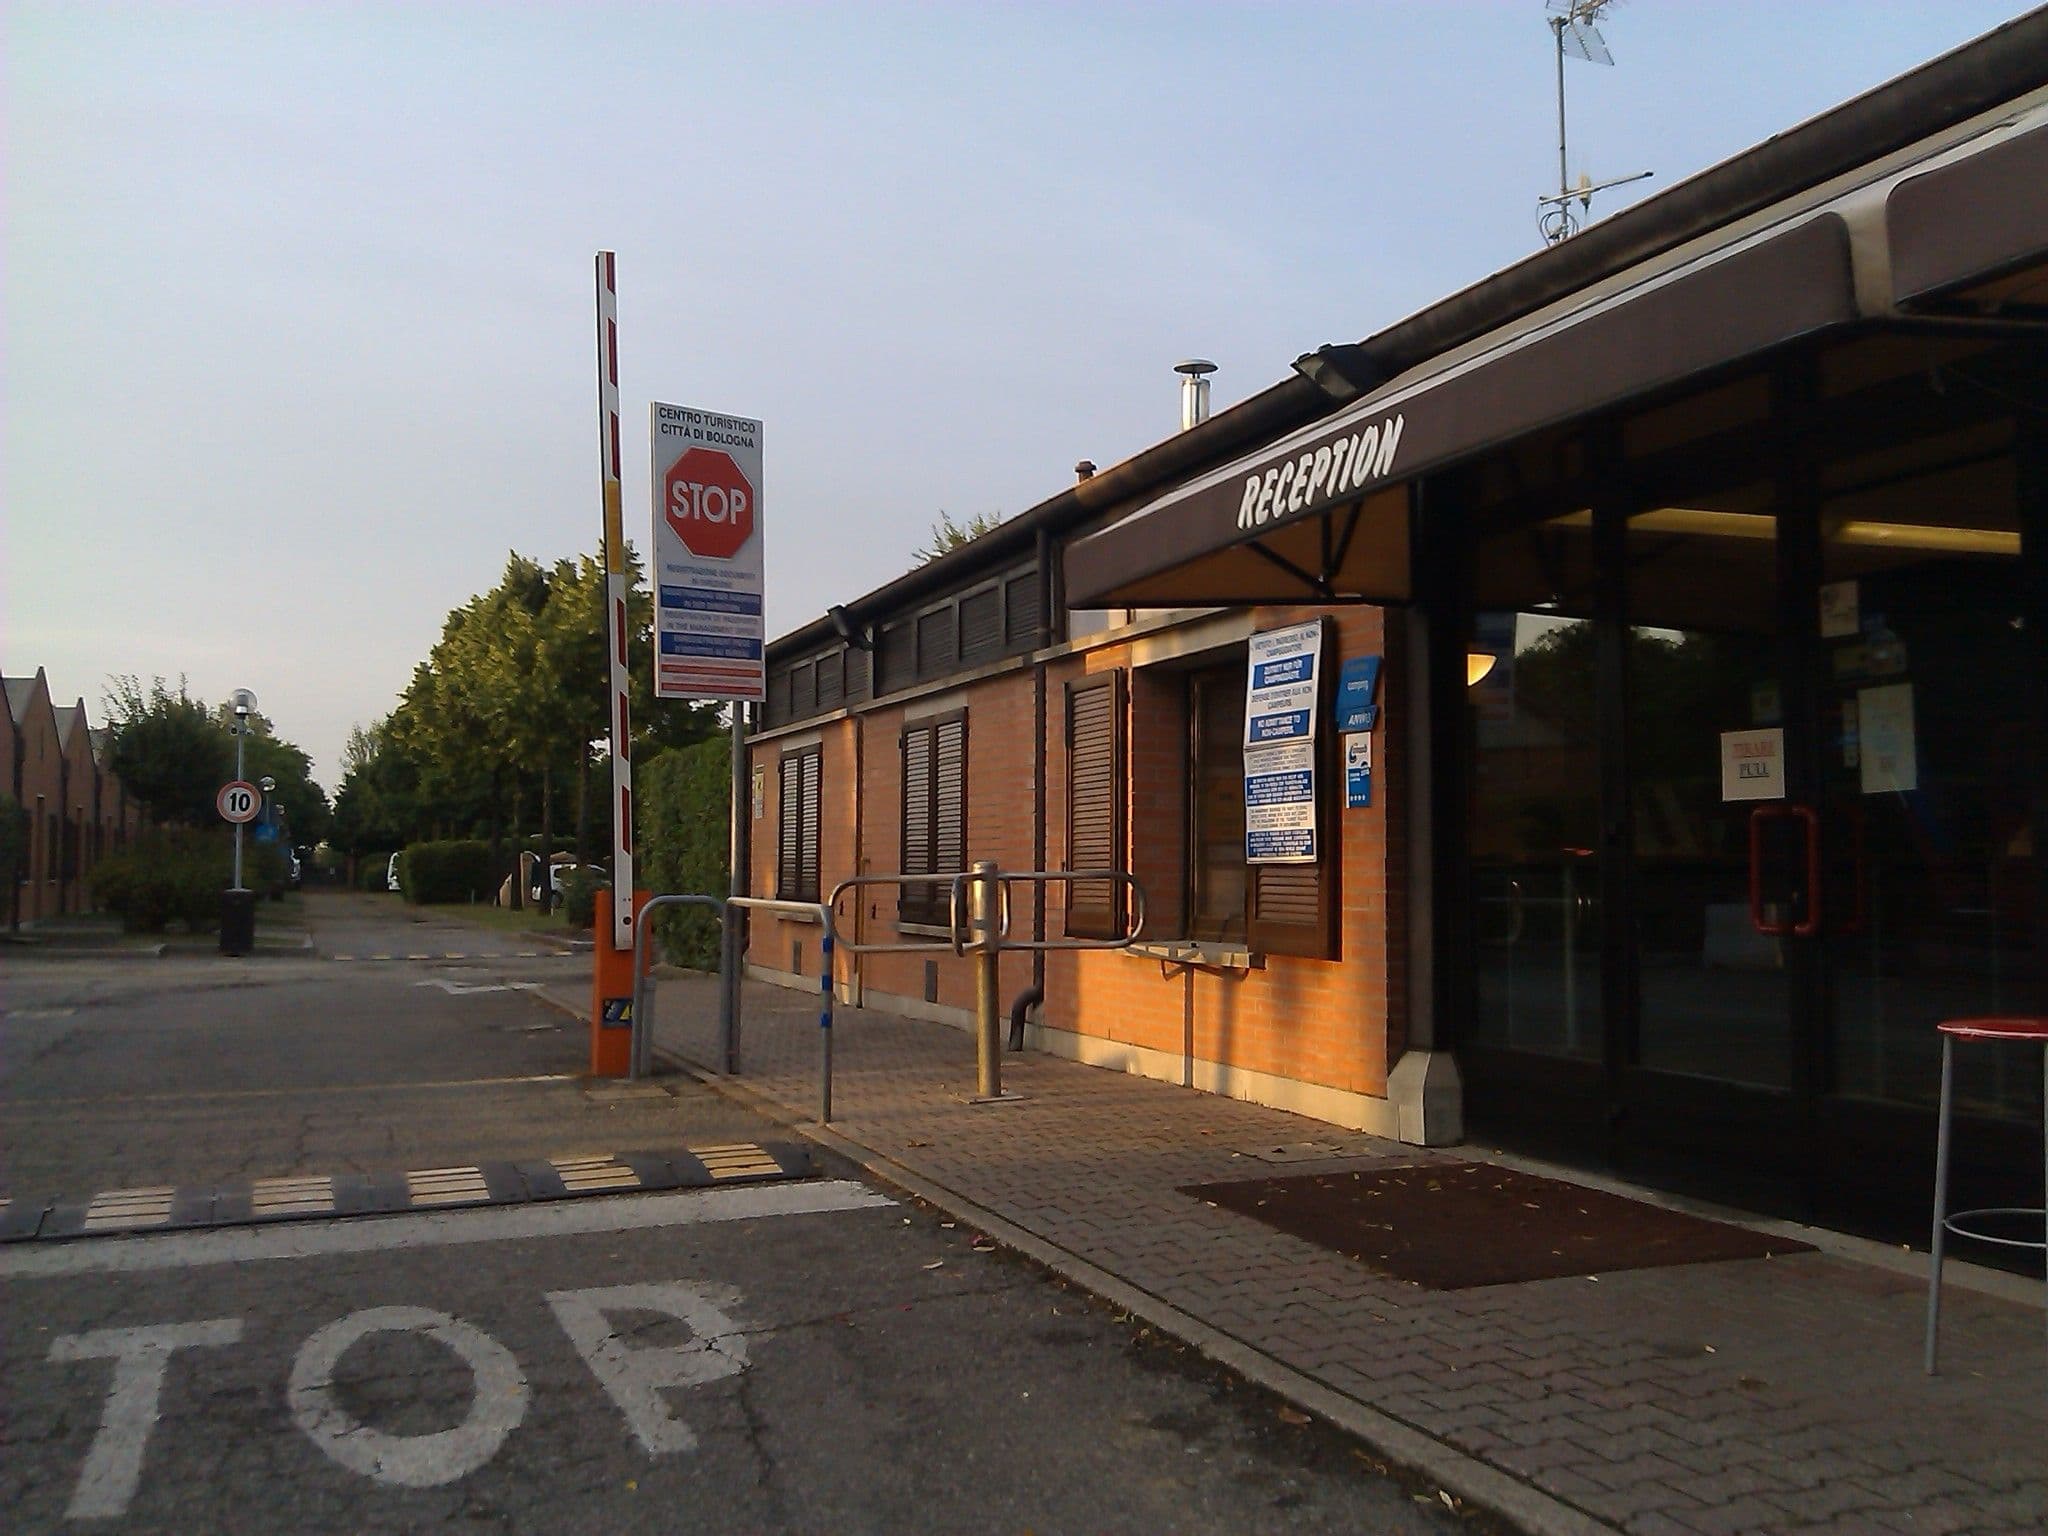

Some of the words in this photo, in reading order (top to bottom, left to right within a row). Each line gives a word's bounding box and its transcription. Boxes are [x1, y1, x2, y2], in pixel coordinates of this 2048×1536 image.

[659, 407, 702, 424] CENTRO
[703, 415, 756, 433] TURISTICO
[661, 423, 691, 438] CITTÀ
[693, 428, 704, 440] DI
[706, 430, 755, 448] BOLOGNA
[1236, 413, 1405, 530] RECEPTION
[671, 480, 747, 525] STOP
[229, 792, 251, 812] 10
